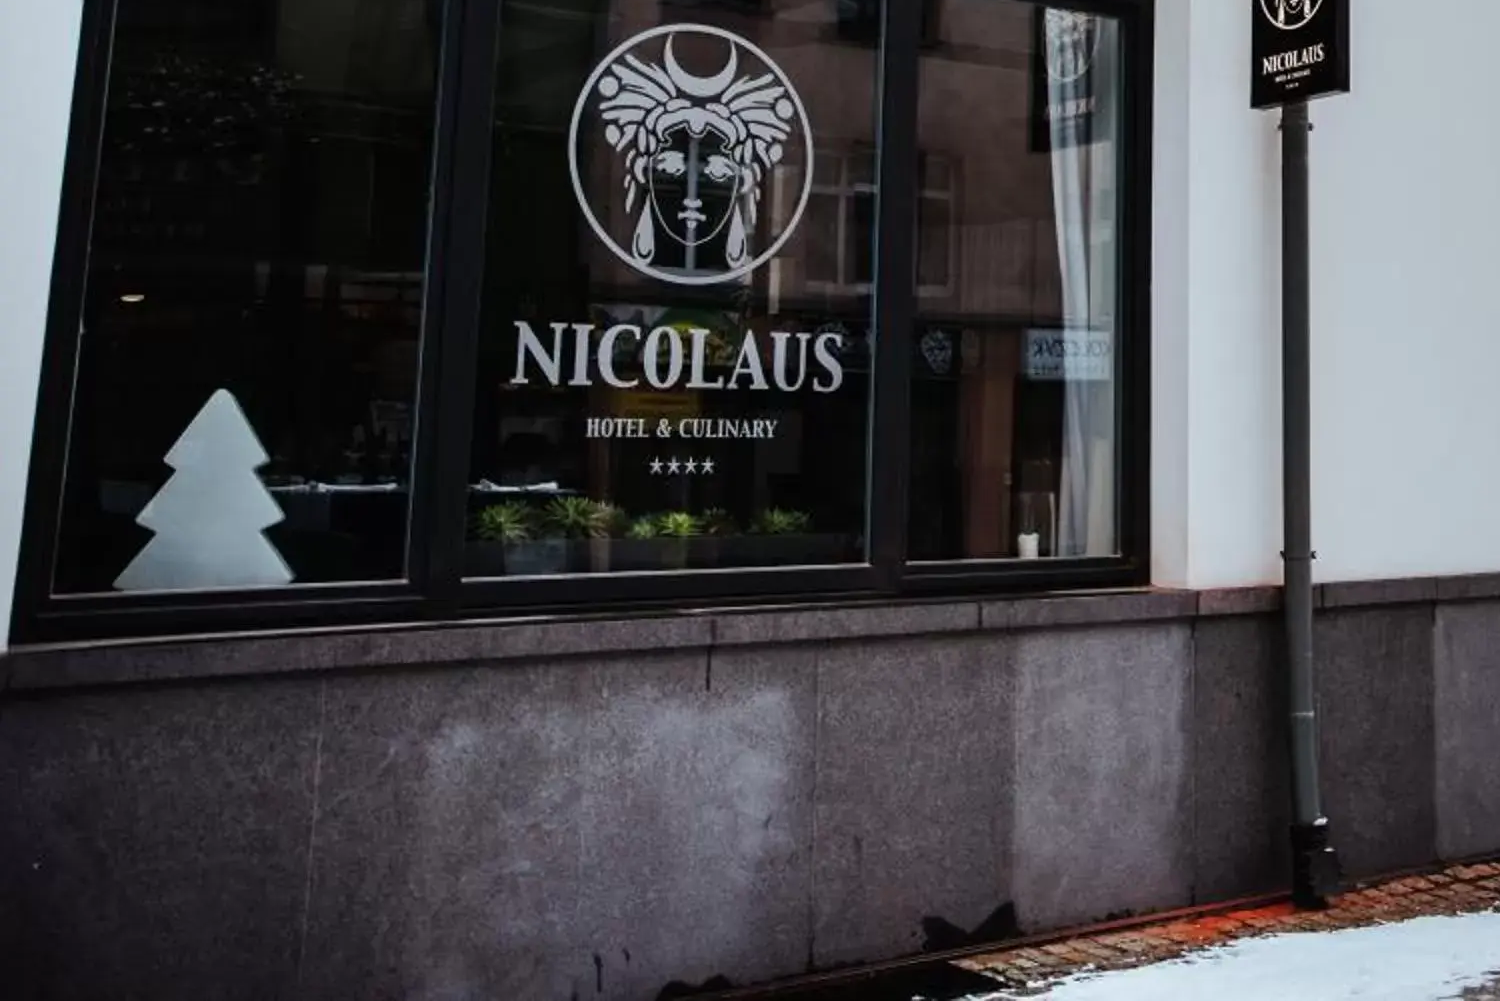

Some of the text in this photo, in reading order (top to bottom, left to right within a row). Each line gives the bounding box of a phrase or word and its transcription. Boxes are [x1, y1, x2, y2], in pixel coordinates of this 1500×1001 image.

[1262, 43, 1325, 76] NICOLAUS
[510, 321, 844, 393] NICOLAUS
[586, 418, 778, 439] HOTEL & CULINARY
